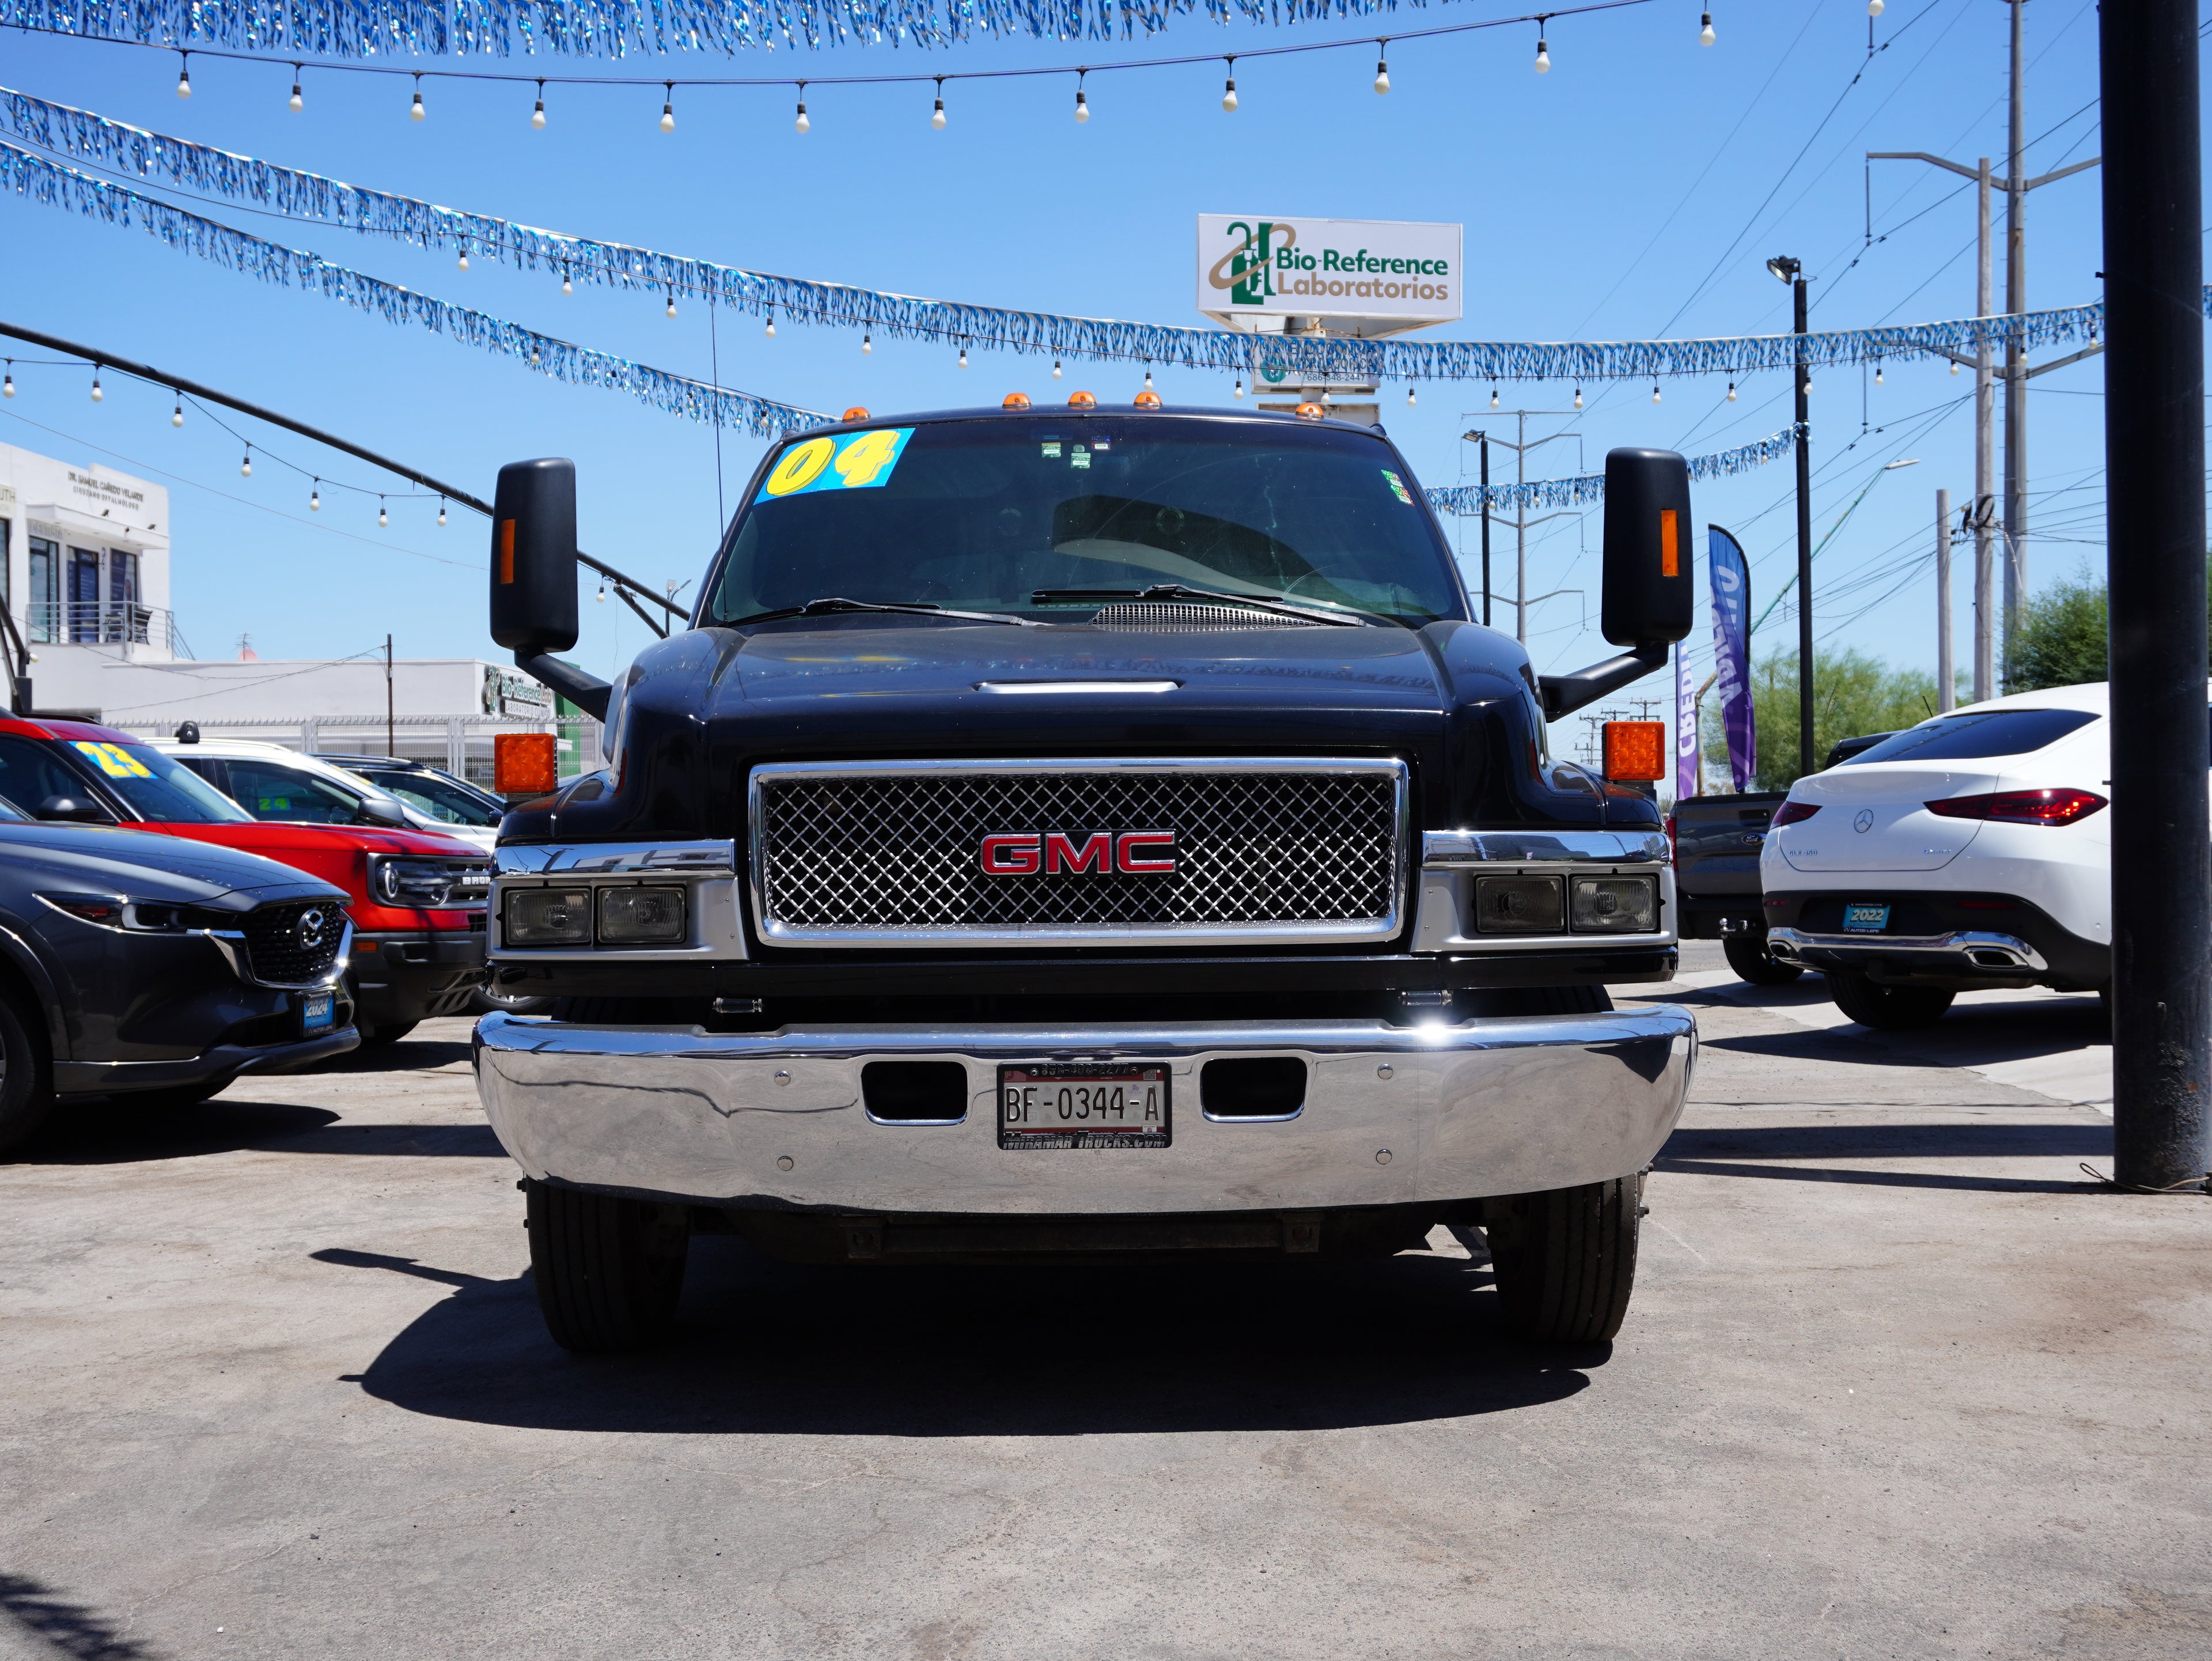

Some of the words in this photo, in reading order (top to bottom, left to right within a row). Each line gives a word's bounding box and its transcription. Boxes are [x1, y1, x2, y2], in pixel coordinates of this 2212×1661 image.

[1277, 247, 1448, 275] Bio-Reference
[1278, 271, 1448, 300] Laboratorios
[767, 431, 900, 495] 04
[68, 471, 77, 482] DR.
[78, 475, 99, 489] SAMUEL
[100, 480, 120, 495] CAÑEDO
[122, 487, 143, 502] VELARDE
[73, 486, 100, 499] CIRUJANO
[502, 675, 540, 701] Bio-Reference
[505, 702, 533, 715] LABORATORIO
[75, 741, 150, 777] 23
[980, 831, 1176, 876] GMC
[463, 876, 491, 885] BRON
[1850, 909, 1885, 922] 2022
[306, 998, 328, 1017] 2024
[1006, 1087, 1159, 1122] BF-0344-A
